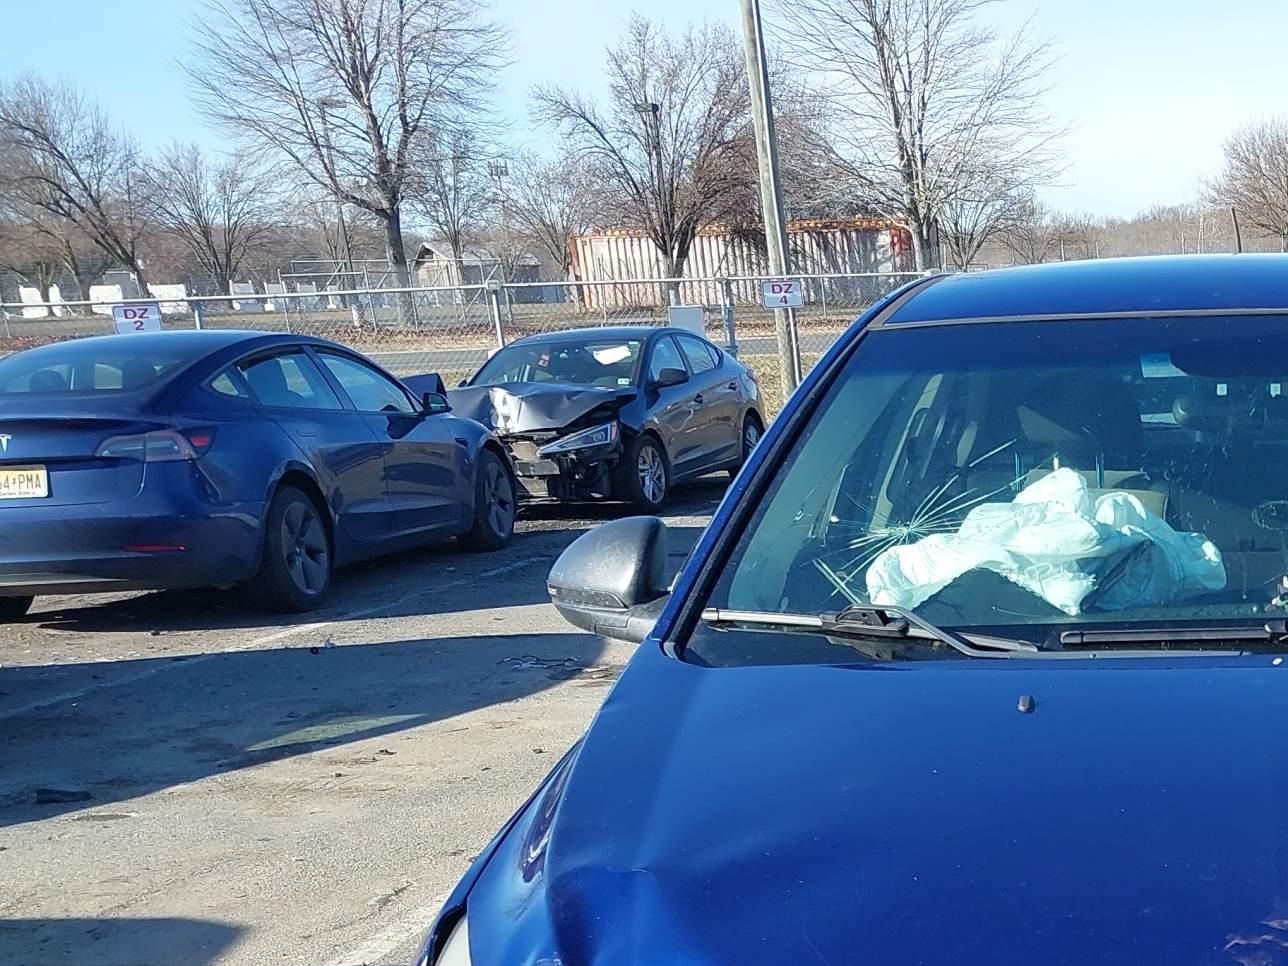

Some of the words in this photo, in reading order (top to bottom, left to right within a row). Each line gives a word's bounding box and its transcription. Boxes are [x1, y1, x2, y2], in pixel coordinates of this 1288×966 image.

[771, 283, 793, 294] DZ
[779, 295, 788, 305] 4
[123, 308, 150, 320] DZ
[133, 320, 145, 331] 2
